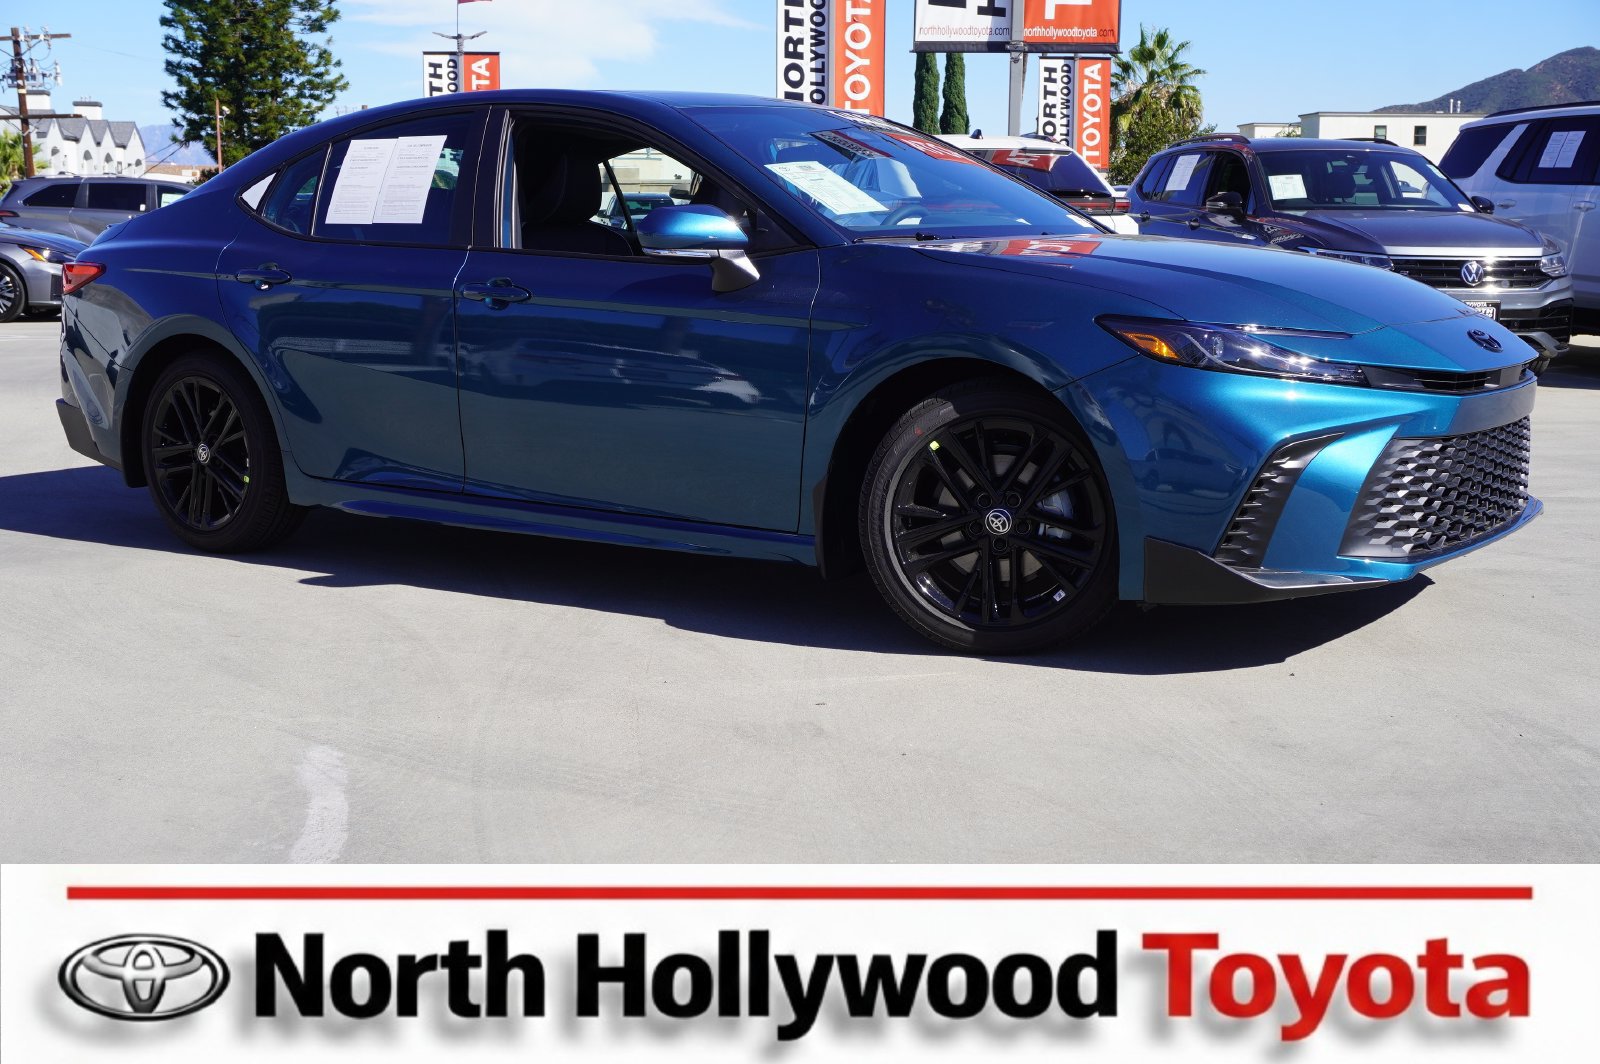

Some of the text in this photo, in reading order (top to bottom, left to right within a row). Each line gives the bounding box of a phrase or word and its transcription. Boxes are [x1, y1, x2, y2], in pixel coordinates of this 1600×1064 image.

[844, 0, 872, 114] TOYOT
[919, 25, 1010, 38] northhollywoodtoyota.com
[1023, 25, 1115, 39] northhollywoodtoyota.com
[1082, 63, 1102, 161] TOYOTA
